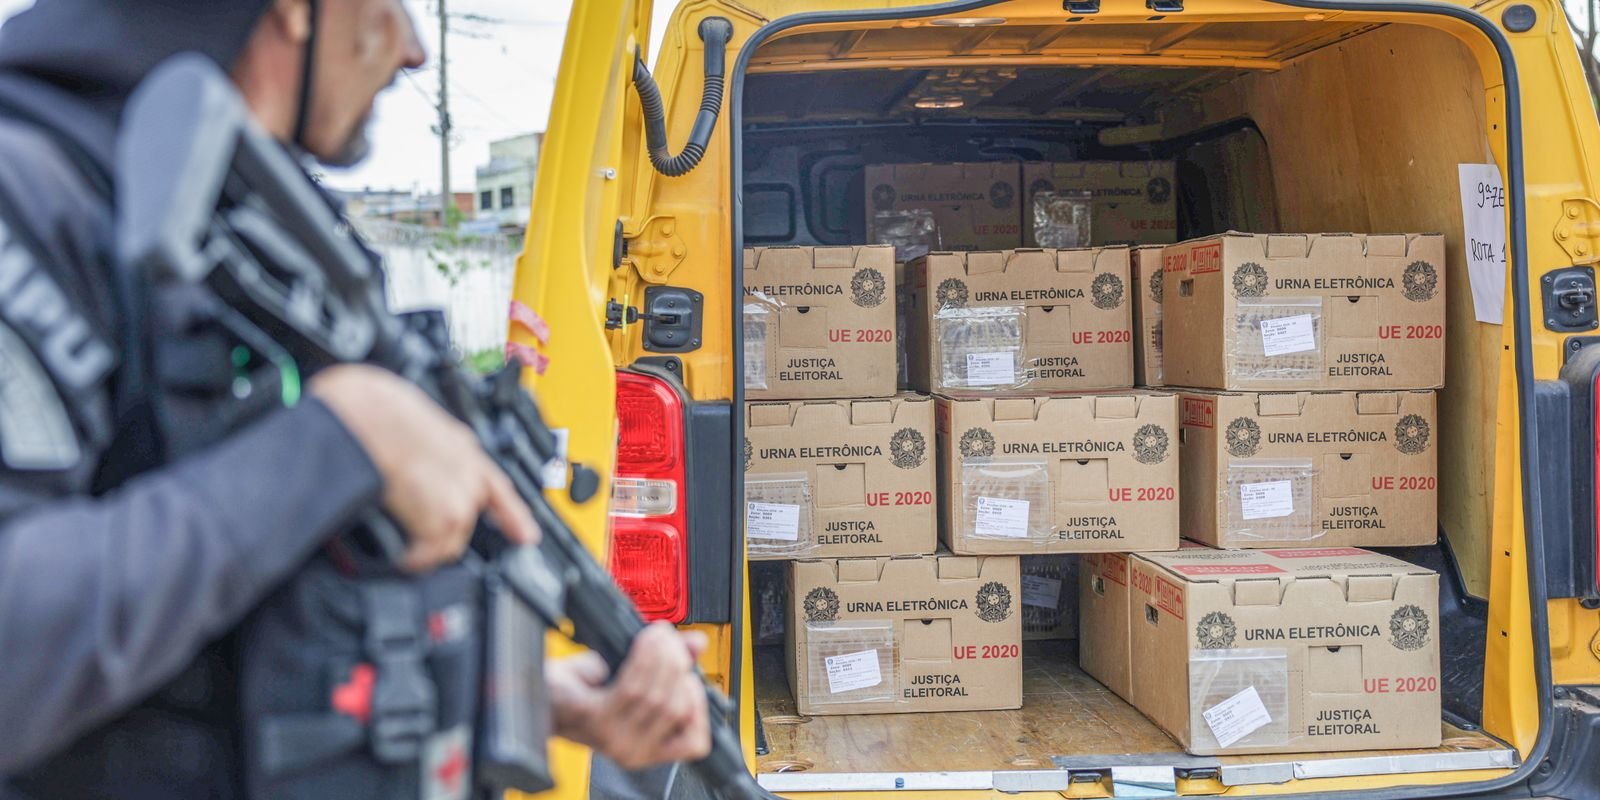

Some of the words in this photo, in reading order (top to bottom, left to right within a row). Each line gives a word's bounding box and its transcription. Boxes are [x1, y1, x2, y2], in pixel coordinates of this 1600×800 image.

[1471, 238, 1495, 263] ROTA
[1172, 253, 1188, 272] 2020
[763, 282, 843, 296] ELETRÔNICA
[1275, 279, 1311, 289] URNA
[1314, 275, 1395, 289] ELETRÔNICA
[975, 290, 1008, 302] URNA
[1011, 287, 1085, 301] ELETRÔNICA
[829, 329, 851, 343] UE
[856, 329, 893, 343] 2020
[1072, 331, 1093, 345] UE
[1097, 330, 1131, 344] 2020
[1378, 326, 1401, 339] UE
[1406, 325, 1443, 339] 2020
[787, 358, 836, 370] JUSTIÇA
[1033, 357, 1079, 370] JUSTIÇA
[1336, 353, 1386, 366] JUSTIÇA
[780, 370, 844, 381] ELEITORAL
[1328, 366, 1393, 377] ELEITORAL
[1267, 431, 1304, 444] URNA
[1307, 429, 1387, 443] ELETRÔNICA
[760, 448, 797, 459] URNA
[800, 444, 882, 458] ELETRÔNICA
[1002, 443, 1039, 454] URNA
[1042, 439, 1125, 453] ELETRÔNICA
[1372, 476, 1394, 490] UE
[1399, 476, 1436, 490] 2020
[867, 493, 889, 507] UE
[895, 491, 932, 506] 2020
[1109, 488, 1132, 502] UE
[1137, 487, 1175, 501] 2020
[1329, 506, 1378, 518] JUSTIÇA
[825, 521, 875, 533] JUSTIÇA
[1066, 516, 1117, 528] JUSTIÇA
[1322, 519, 1386, 530] ELEITORAL
[817, 534, 883, 545] ELEITORAL
[1059, 529, 1125, 540] ELEITORAL
[847, 601, 883, 613] URNA
[886, 597, 968, 612] ELETRÔNICA
[1244, 628, 1285, 641] URNA
[1289, 623, 1381, 639] ELETRÔNICA
[954, 646, 977, 660] UE
[981, 644, 1019, 659] 2020
[911, 674, 961, 687] JUSTIÇA
[1364, 678, 1389, 694] UE
[1395, 676, 1437, 692] 2020
[904, 687, 968, 698] ELEITORAL
[1316, 709, 1372, 722] JUSTIÇA
[1308, 723, 1381, 736] ELEITORAL
